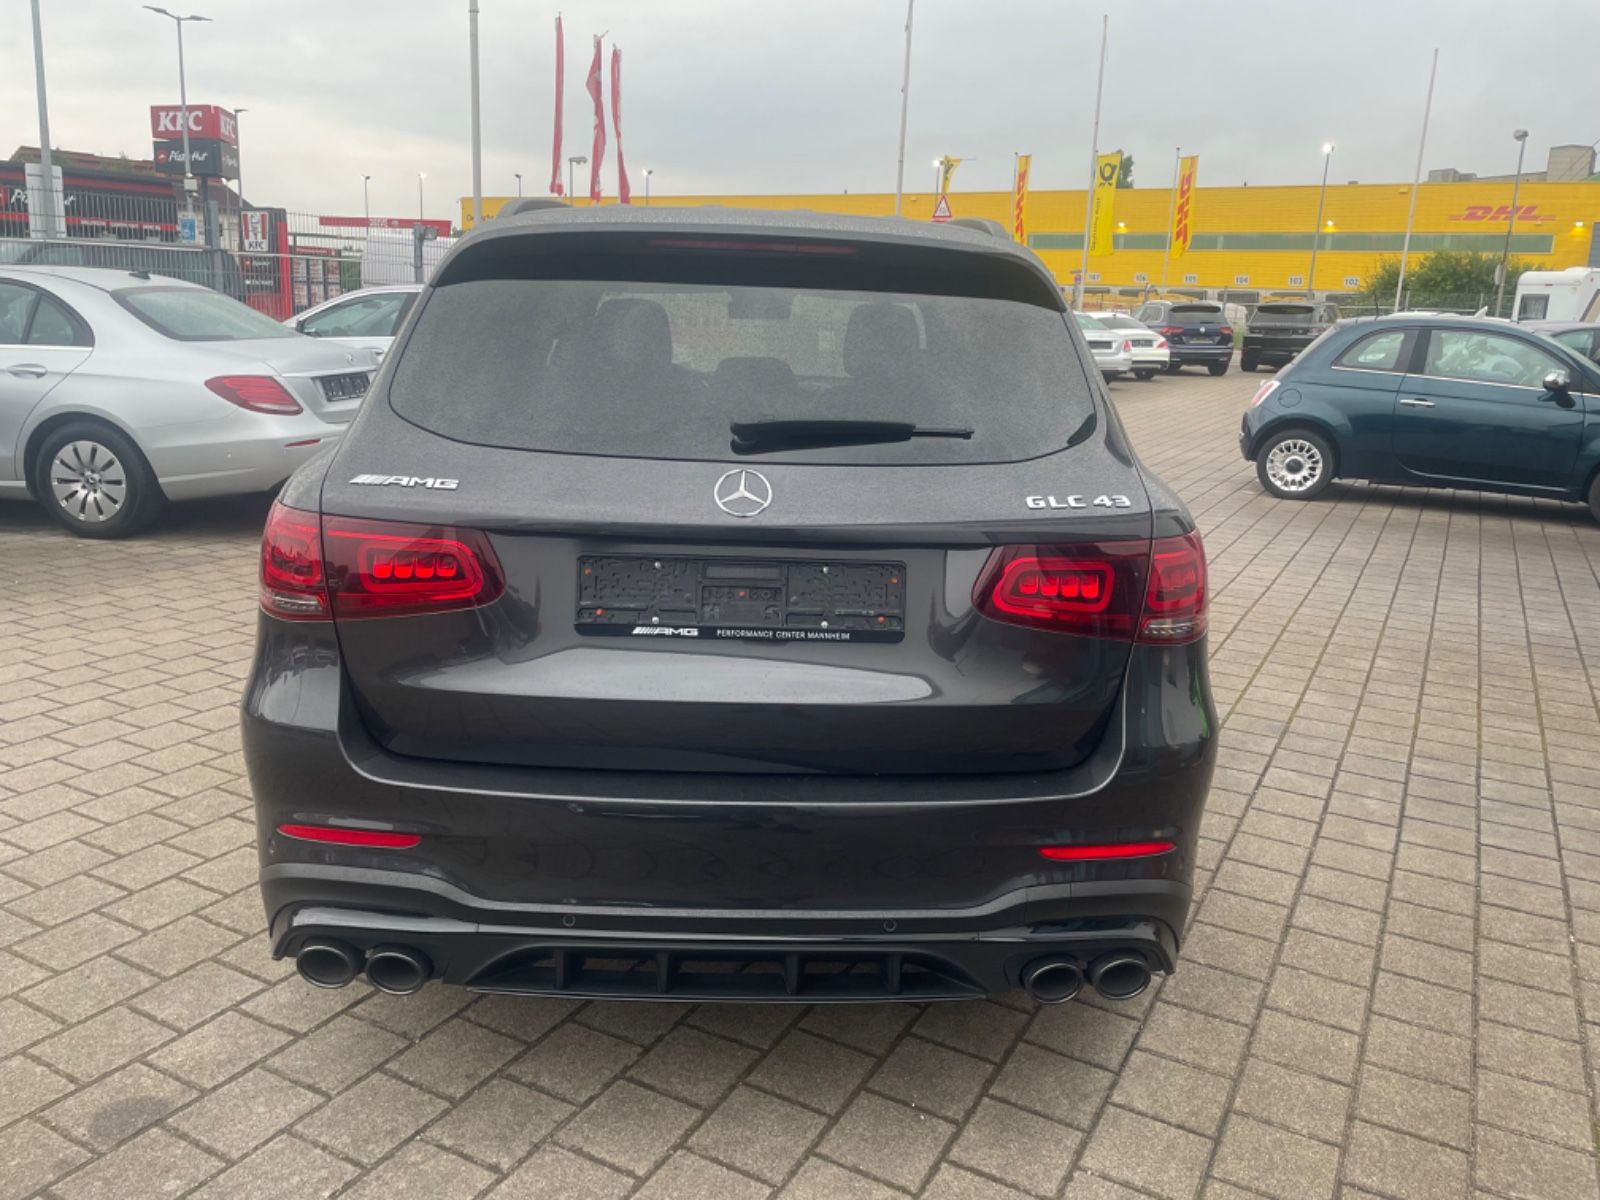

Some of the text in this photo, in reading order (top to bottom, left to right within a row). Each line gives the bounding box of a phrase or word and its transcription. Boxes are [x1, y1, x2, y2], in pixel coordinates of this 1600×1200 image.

[157, 110, 203, 131] KFC
[1176, 171, 1193, 246] DHL
[1463, 205, 1541, 221] DHL
[381, 476, 460, 490] AMG
[1026, 495, 1131, 509] GLC 43
[716, 629, 774, 639] PERFORMANCE
[776, 630, 806, 640] CENTER
[807, 631, 851, 641] MANNHEIM
